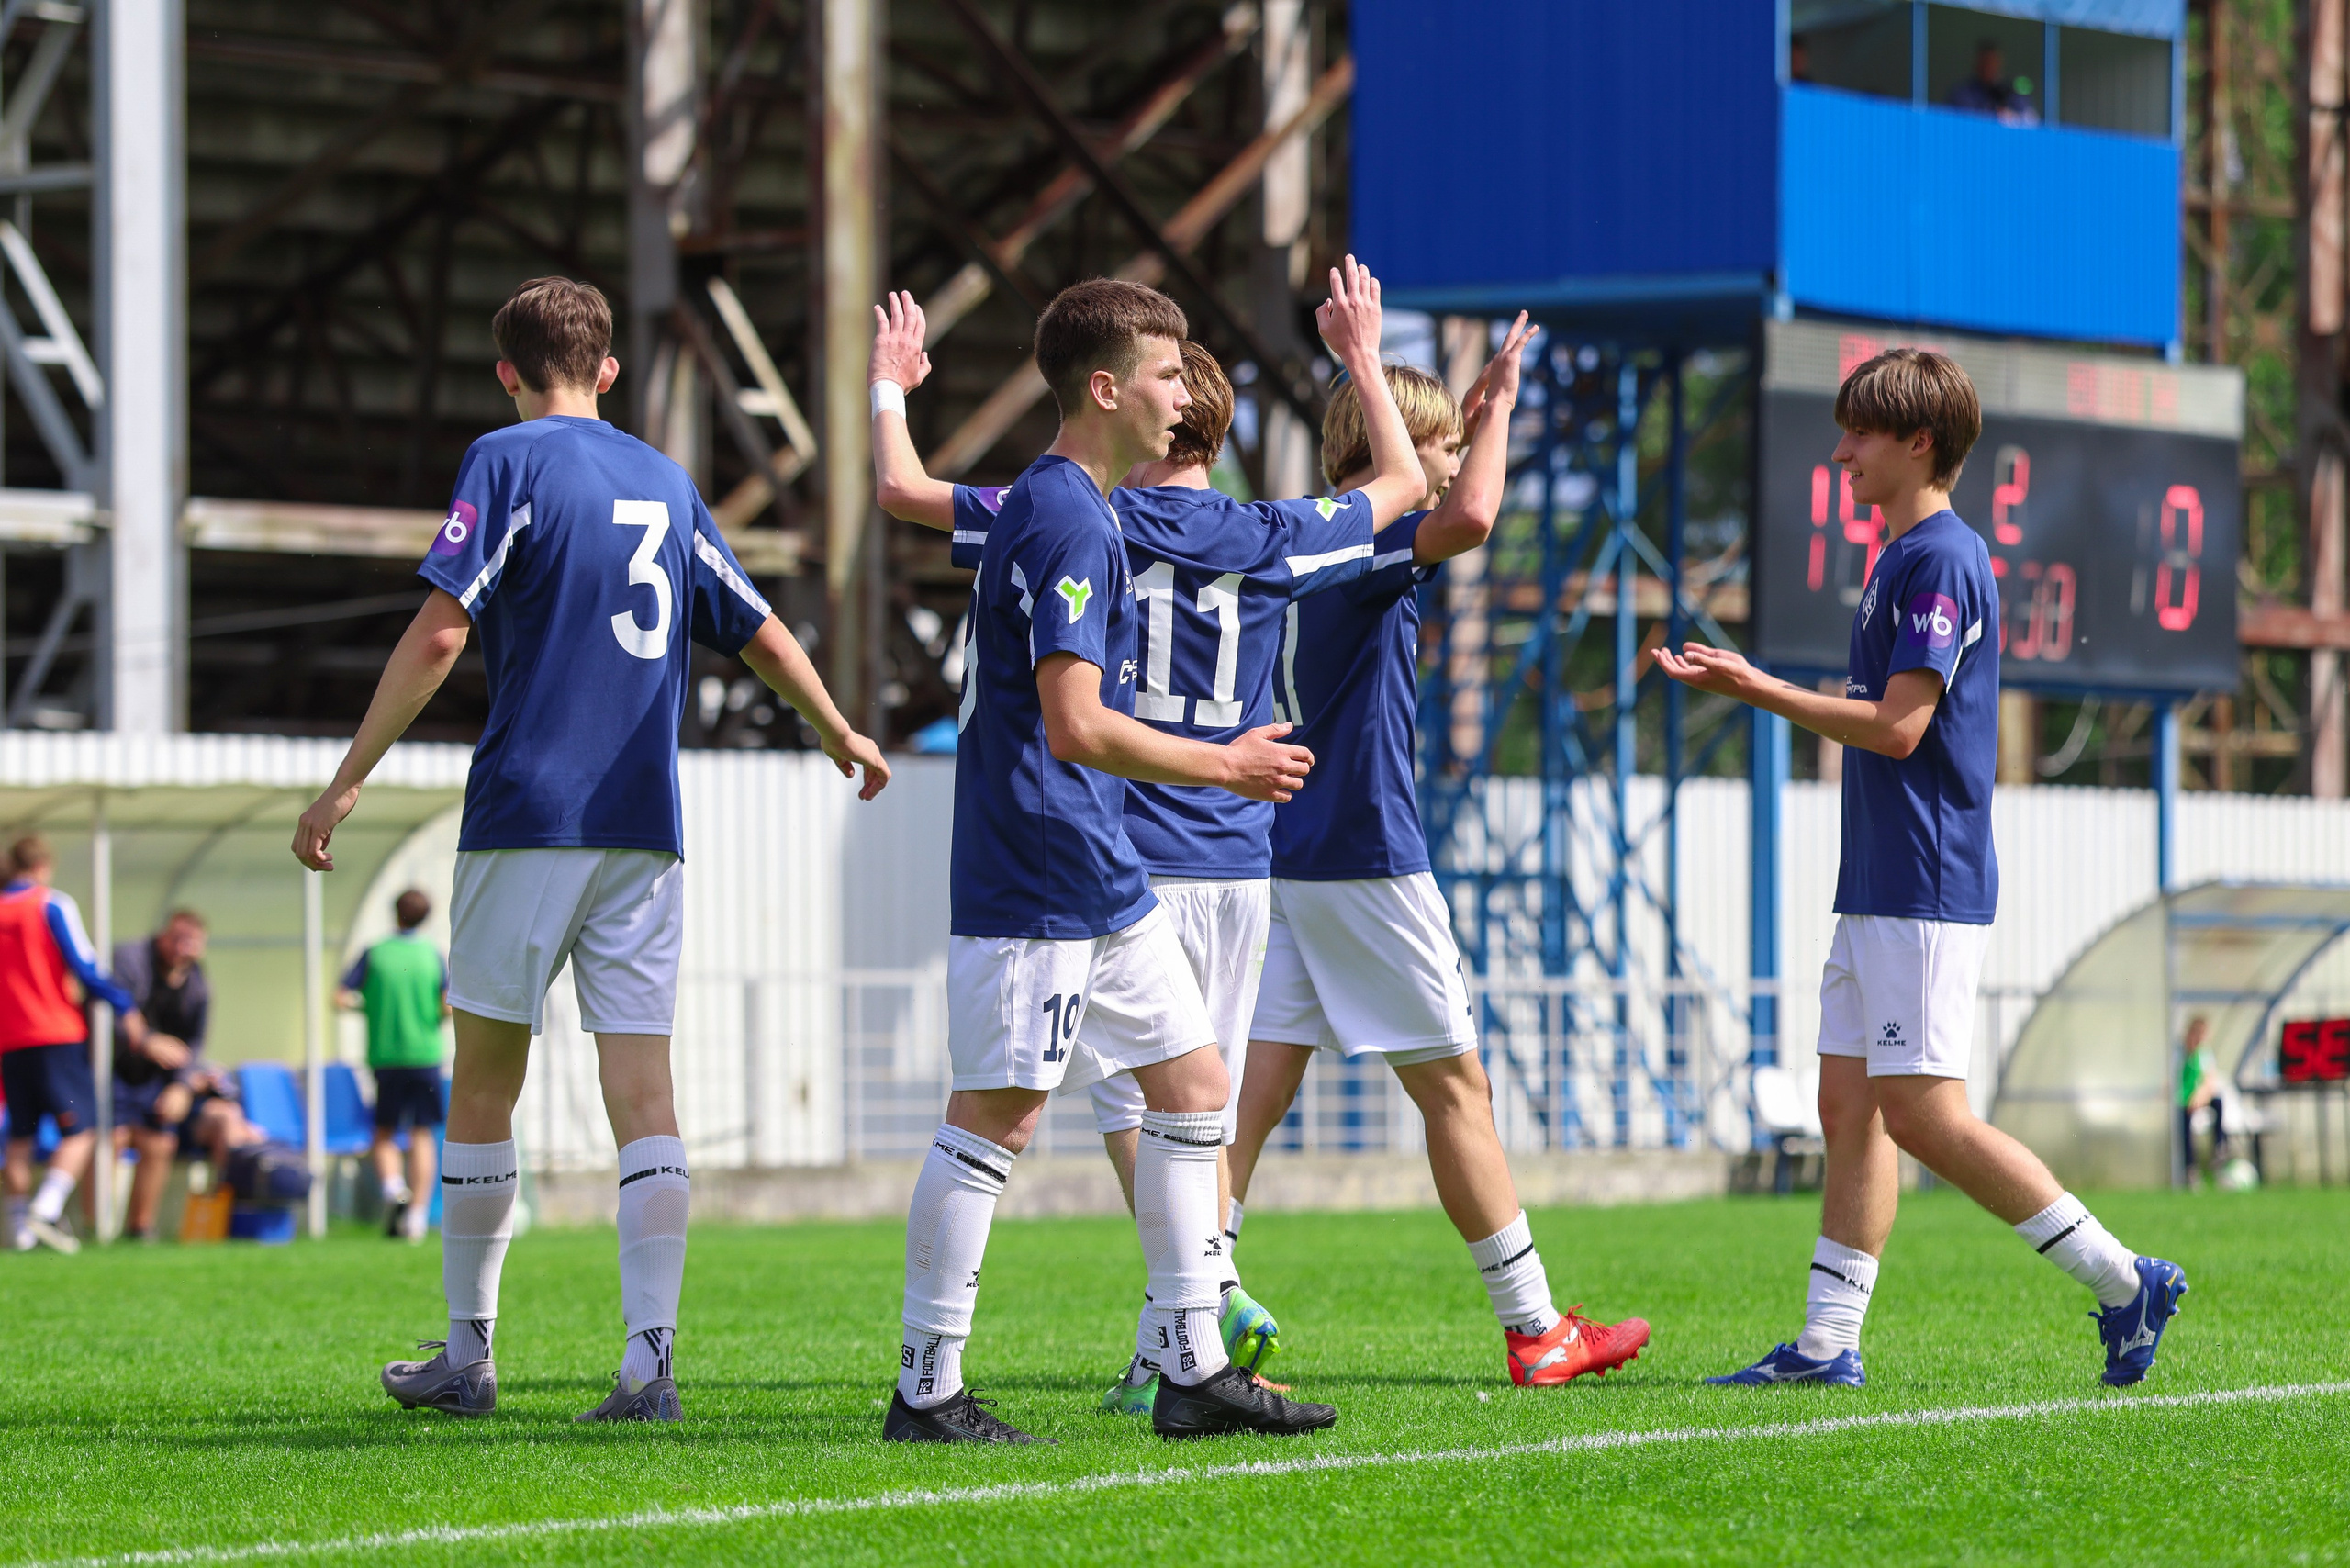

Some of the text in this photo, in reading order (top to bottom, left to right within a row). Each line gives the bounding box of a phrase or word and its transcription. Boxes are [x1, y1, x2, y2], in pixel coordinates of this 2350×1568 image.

[441, 510, 467, 543] b
[2154, 485, 2204, 631] 0
[610, 499, 672, 659] 3
[1133, 560, 1245, 728] 11
[1912, 604, 1953, 637] wb
[1042, 993, 1080, 1063] 19
[661, 1166, 689, 1179] KEL
